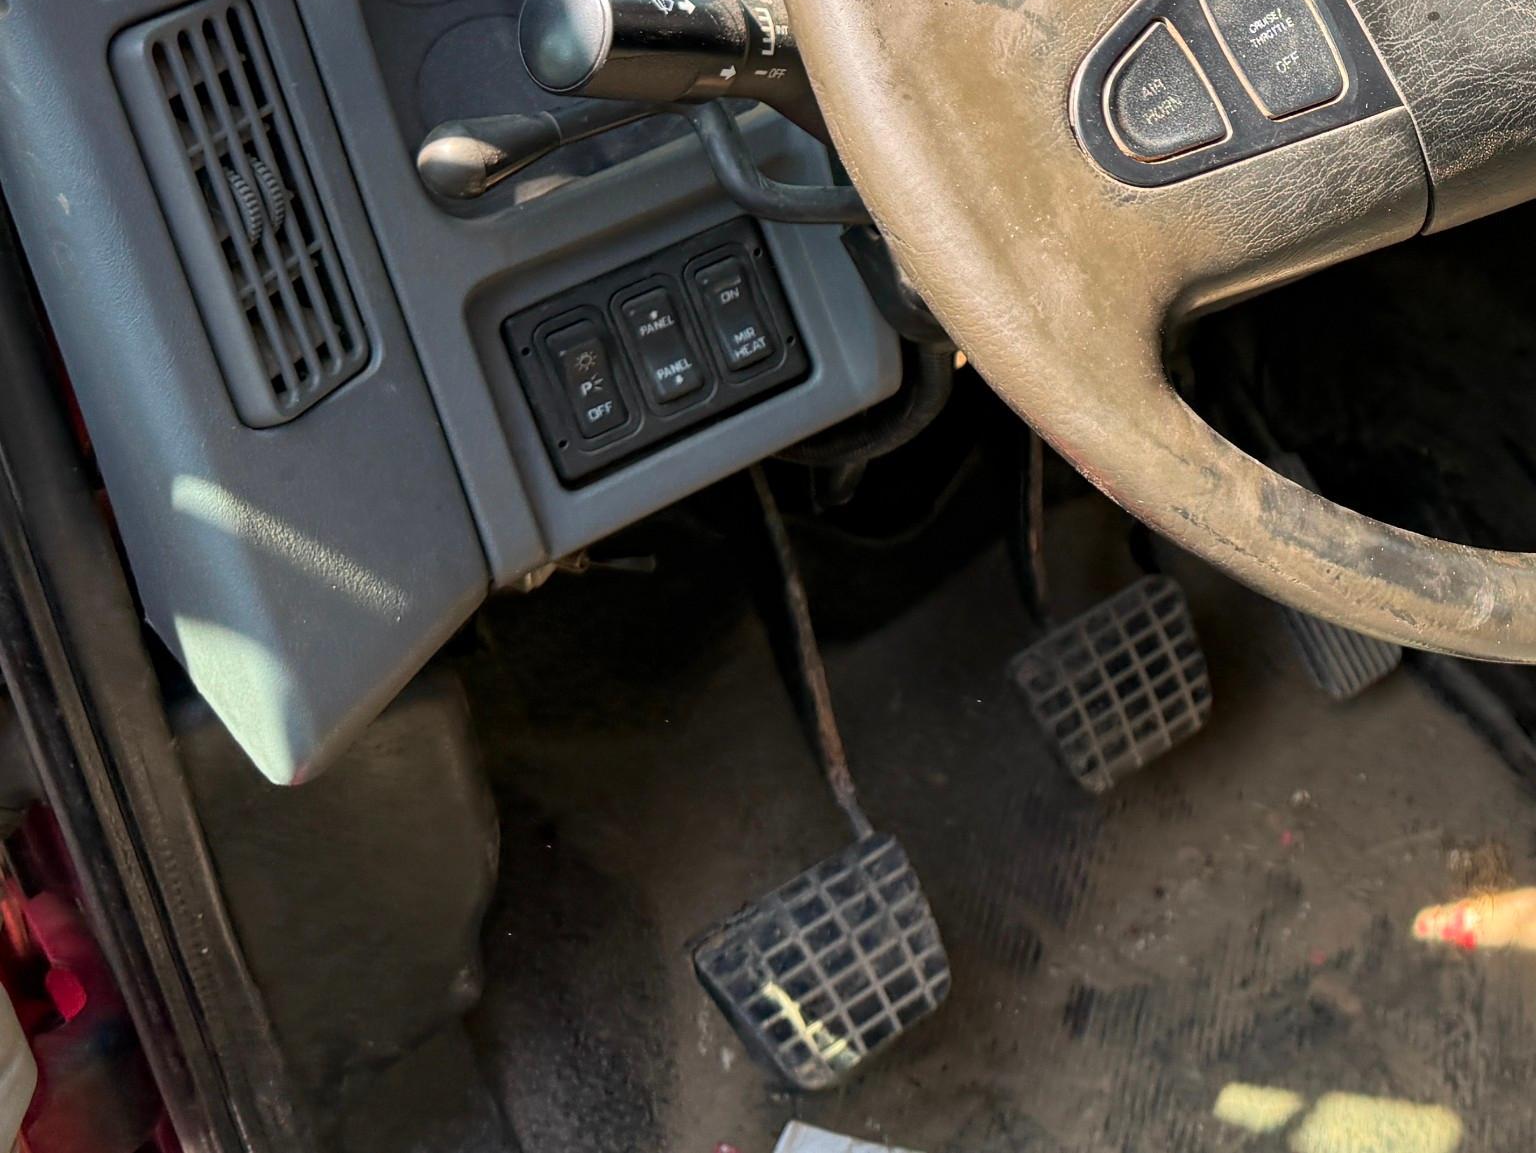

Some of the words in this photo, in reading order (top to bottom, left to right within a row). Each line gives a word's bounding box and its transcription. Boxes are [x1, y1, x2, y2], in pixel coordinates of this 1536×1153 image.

[1250, 17, 1295, 48] THROTTLE
[1276, 51, 1300, 74] OFF
[768, 68, 787, 79] OFF
[1142, 78, 1165, 99] AIR
[720, 288, 740, 304] ON
[640, 315, 675, 337] PANEL
[733, 326, 756, 345] MIR
[733, 337, 767, 359] HEAT
[656, 359, 692, 380] PANEL
[587, 401, 613, 422] OFF
